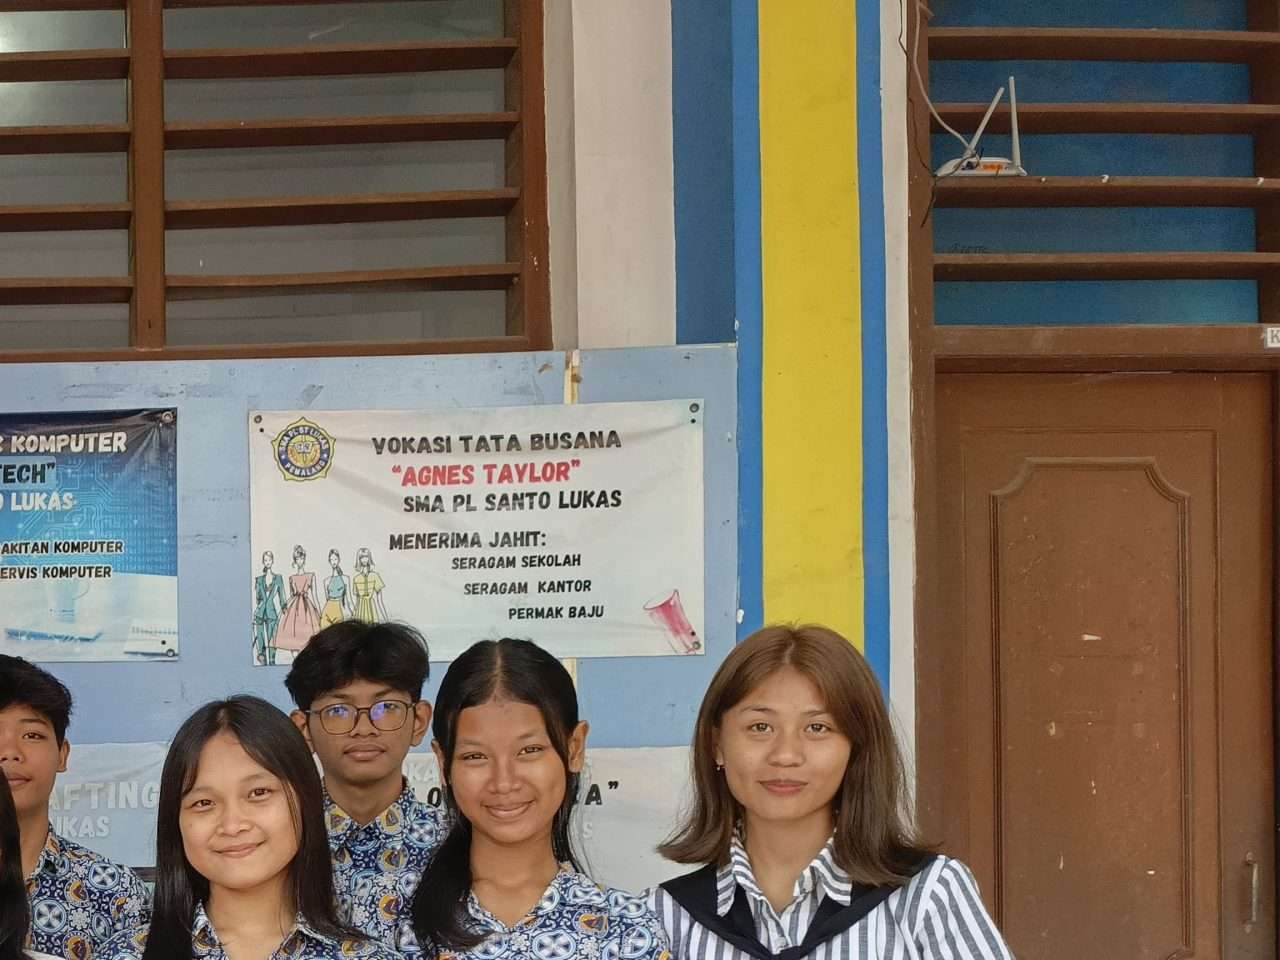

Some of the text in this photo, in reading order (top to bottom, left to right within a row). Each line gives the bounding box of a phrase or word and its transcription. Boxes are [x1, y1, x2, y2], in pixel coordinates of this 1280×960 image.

[11, 431, 128, 454] KOMPUTER
[372, 430, 622, 455] VOKASI TATA BUSANA
[10, 492, 74, 511] LUKAS
[403, 490, 623, 513] SMA PL SANTO LUKAS
[53, 540, 124, 555] KOMPUTER
[389, 530, 547, 551] MENERIMA JAHIT:
[451, 554, 582, 571] SERAGAM SEKOLAH
[42, 564, 112, 580] KOMPUTER
[463, 579, 592, 596] SERAGAM KANTOR
[508, 604, 605, 621] PERMAK BAJU
